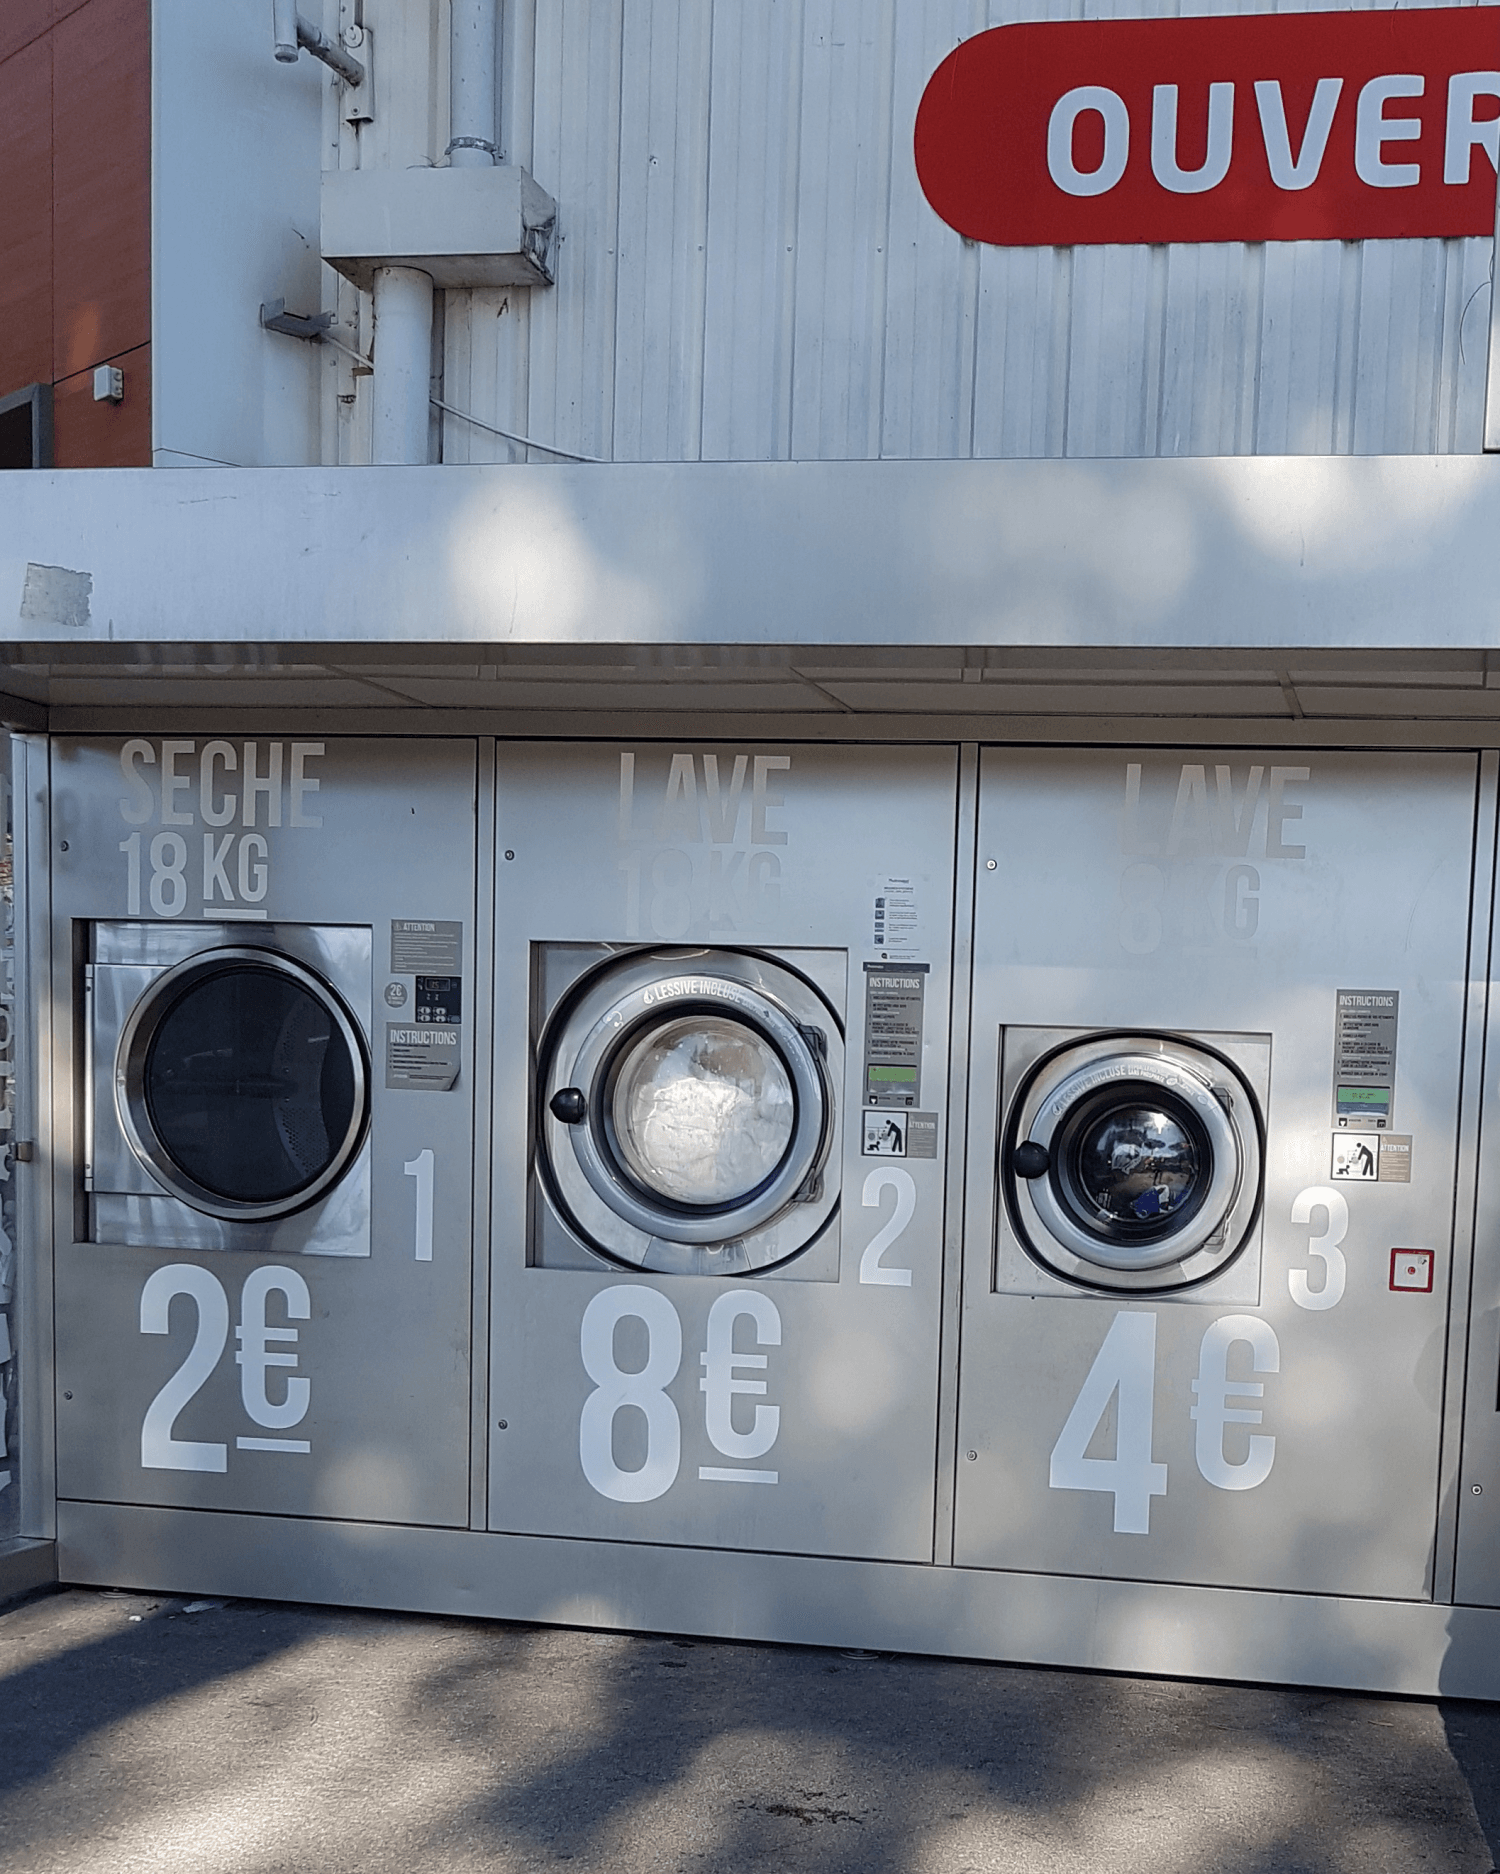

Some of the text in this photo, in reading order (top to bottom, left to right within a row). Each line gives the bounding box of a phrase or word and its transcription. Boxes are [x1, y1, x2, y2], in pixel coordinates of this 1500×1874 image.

[1047, 71, 1499, 197] OUVER
[119, 739, 326, 829] SECHE
[618, 752, 791, 845] LAVE
[1119, 763, 1311, 860] LAVE
[119, 832, 268, 917] 18 KG
[618, 848, 782, 939] 18 KG
[403, 922, 436, 932] ATTENTION
[654, 979, 742, 1004] LESSIVE INCLUSE
[869, 977, 921, 989] INSTRUCTIONS
[1339, 995, 1394, 1007] INSTRUCTIONS
[390, 1029, 457, 1045] INSTRUCTIONS
[1090, 1064, 1126, 1085] INCLUSE
[909, 1121, 936, 1130] ATTENTION
[403, 1148, 434, 1262] 1
[859, 1166, 917, 1288] 2
[1288, 1186, 1350, 1312] 3
